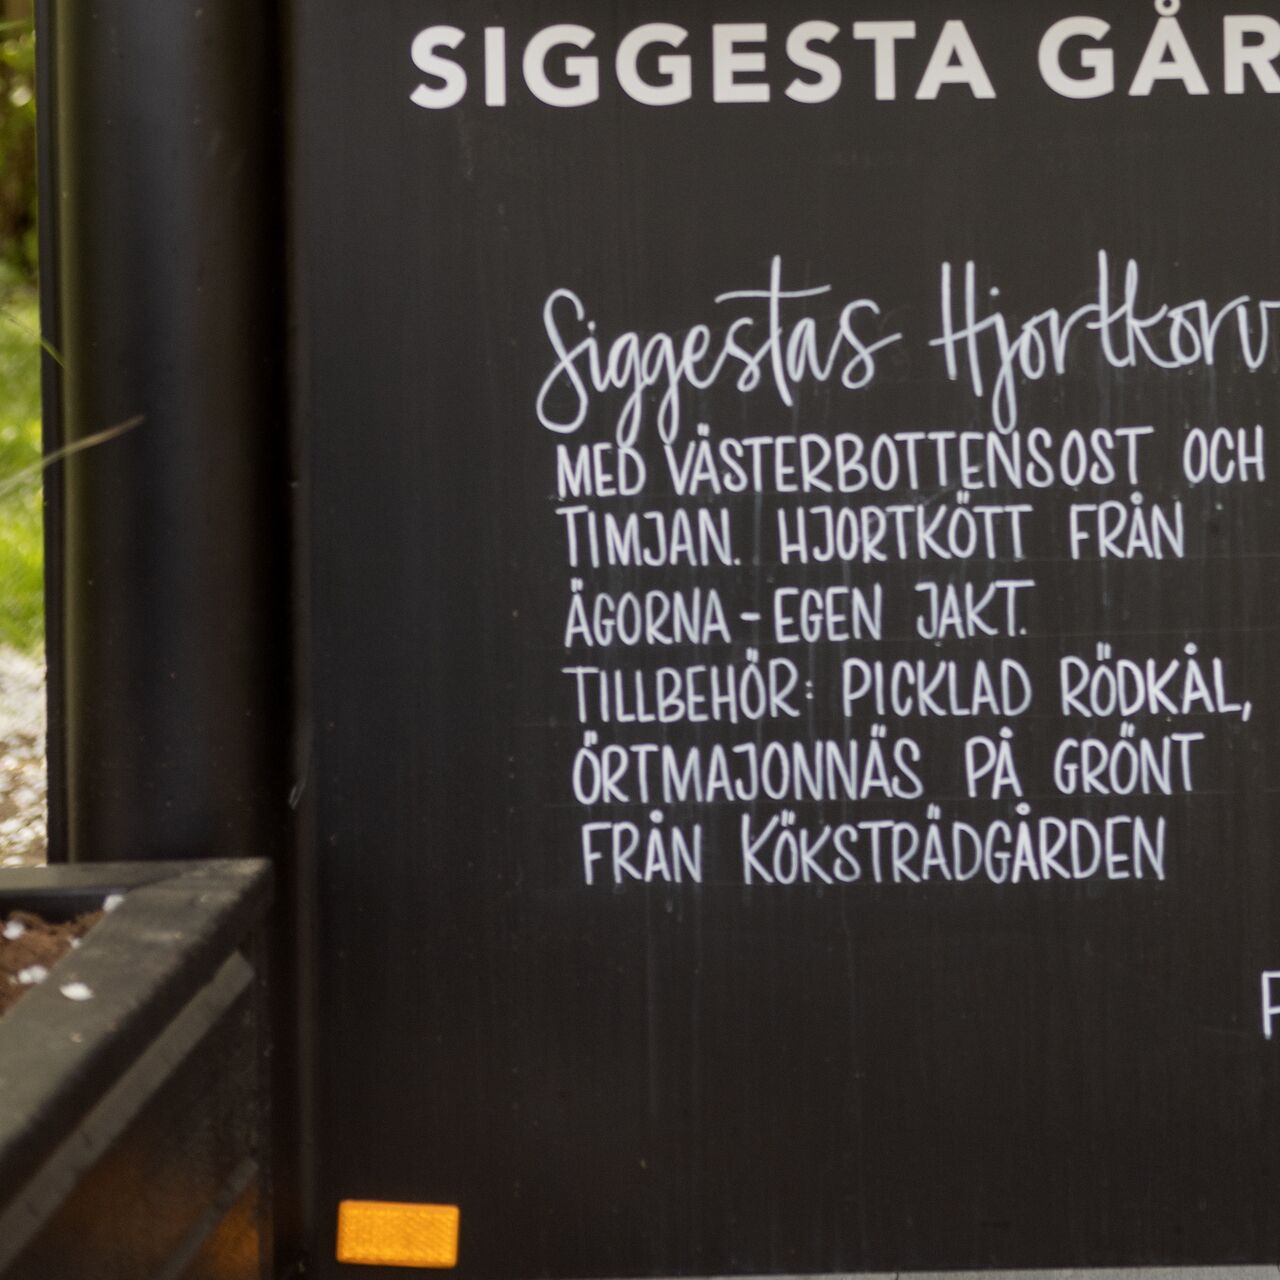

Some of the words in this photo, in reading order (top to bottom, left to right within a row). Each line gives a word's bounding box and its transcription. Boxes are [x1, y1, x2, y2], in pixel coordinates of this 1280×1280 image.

[410, 20, 996, 109] SIGGESTA
[536, 255, 902, 446] Siggestas
[557, 443, 645, 498] MED
[669, 424, 1154, 494] VÄSTERBOTTENSOST
[1183, 425, 1265, 483] OCH
[556, 505, 740, 568] TIMJAN.
[778, 490, 1033, 564] HJORTKÖTT
[1070, 492, 1184, 560] FRÅN
[915, 580, 1035, 639] JAKT.
[563, 648, 813, 723] TILLBEHÖR:
[843, 658, 1031, 717] PICKLAD
[1061, 642, 1251, 721] RÖDKÅL,
[573, 724, 923, 805] ÖRTMAJONNÄS
[965, 727, 1022, 799] PÅ
[1054, 722, 1204, 795] GRÖNT
[582, 810, 701, 884] FRÅN
[742, 803, 1165, 884] KÖKSTRÄDGÅRDEN
